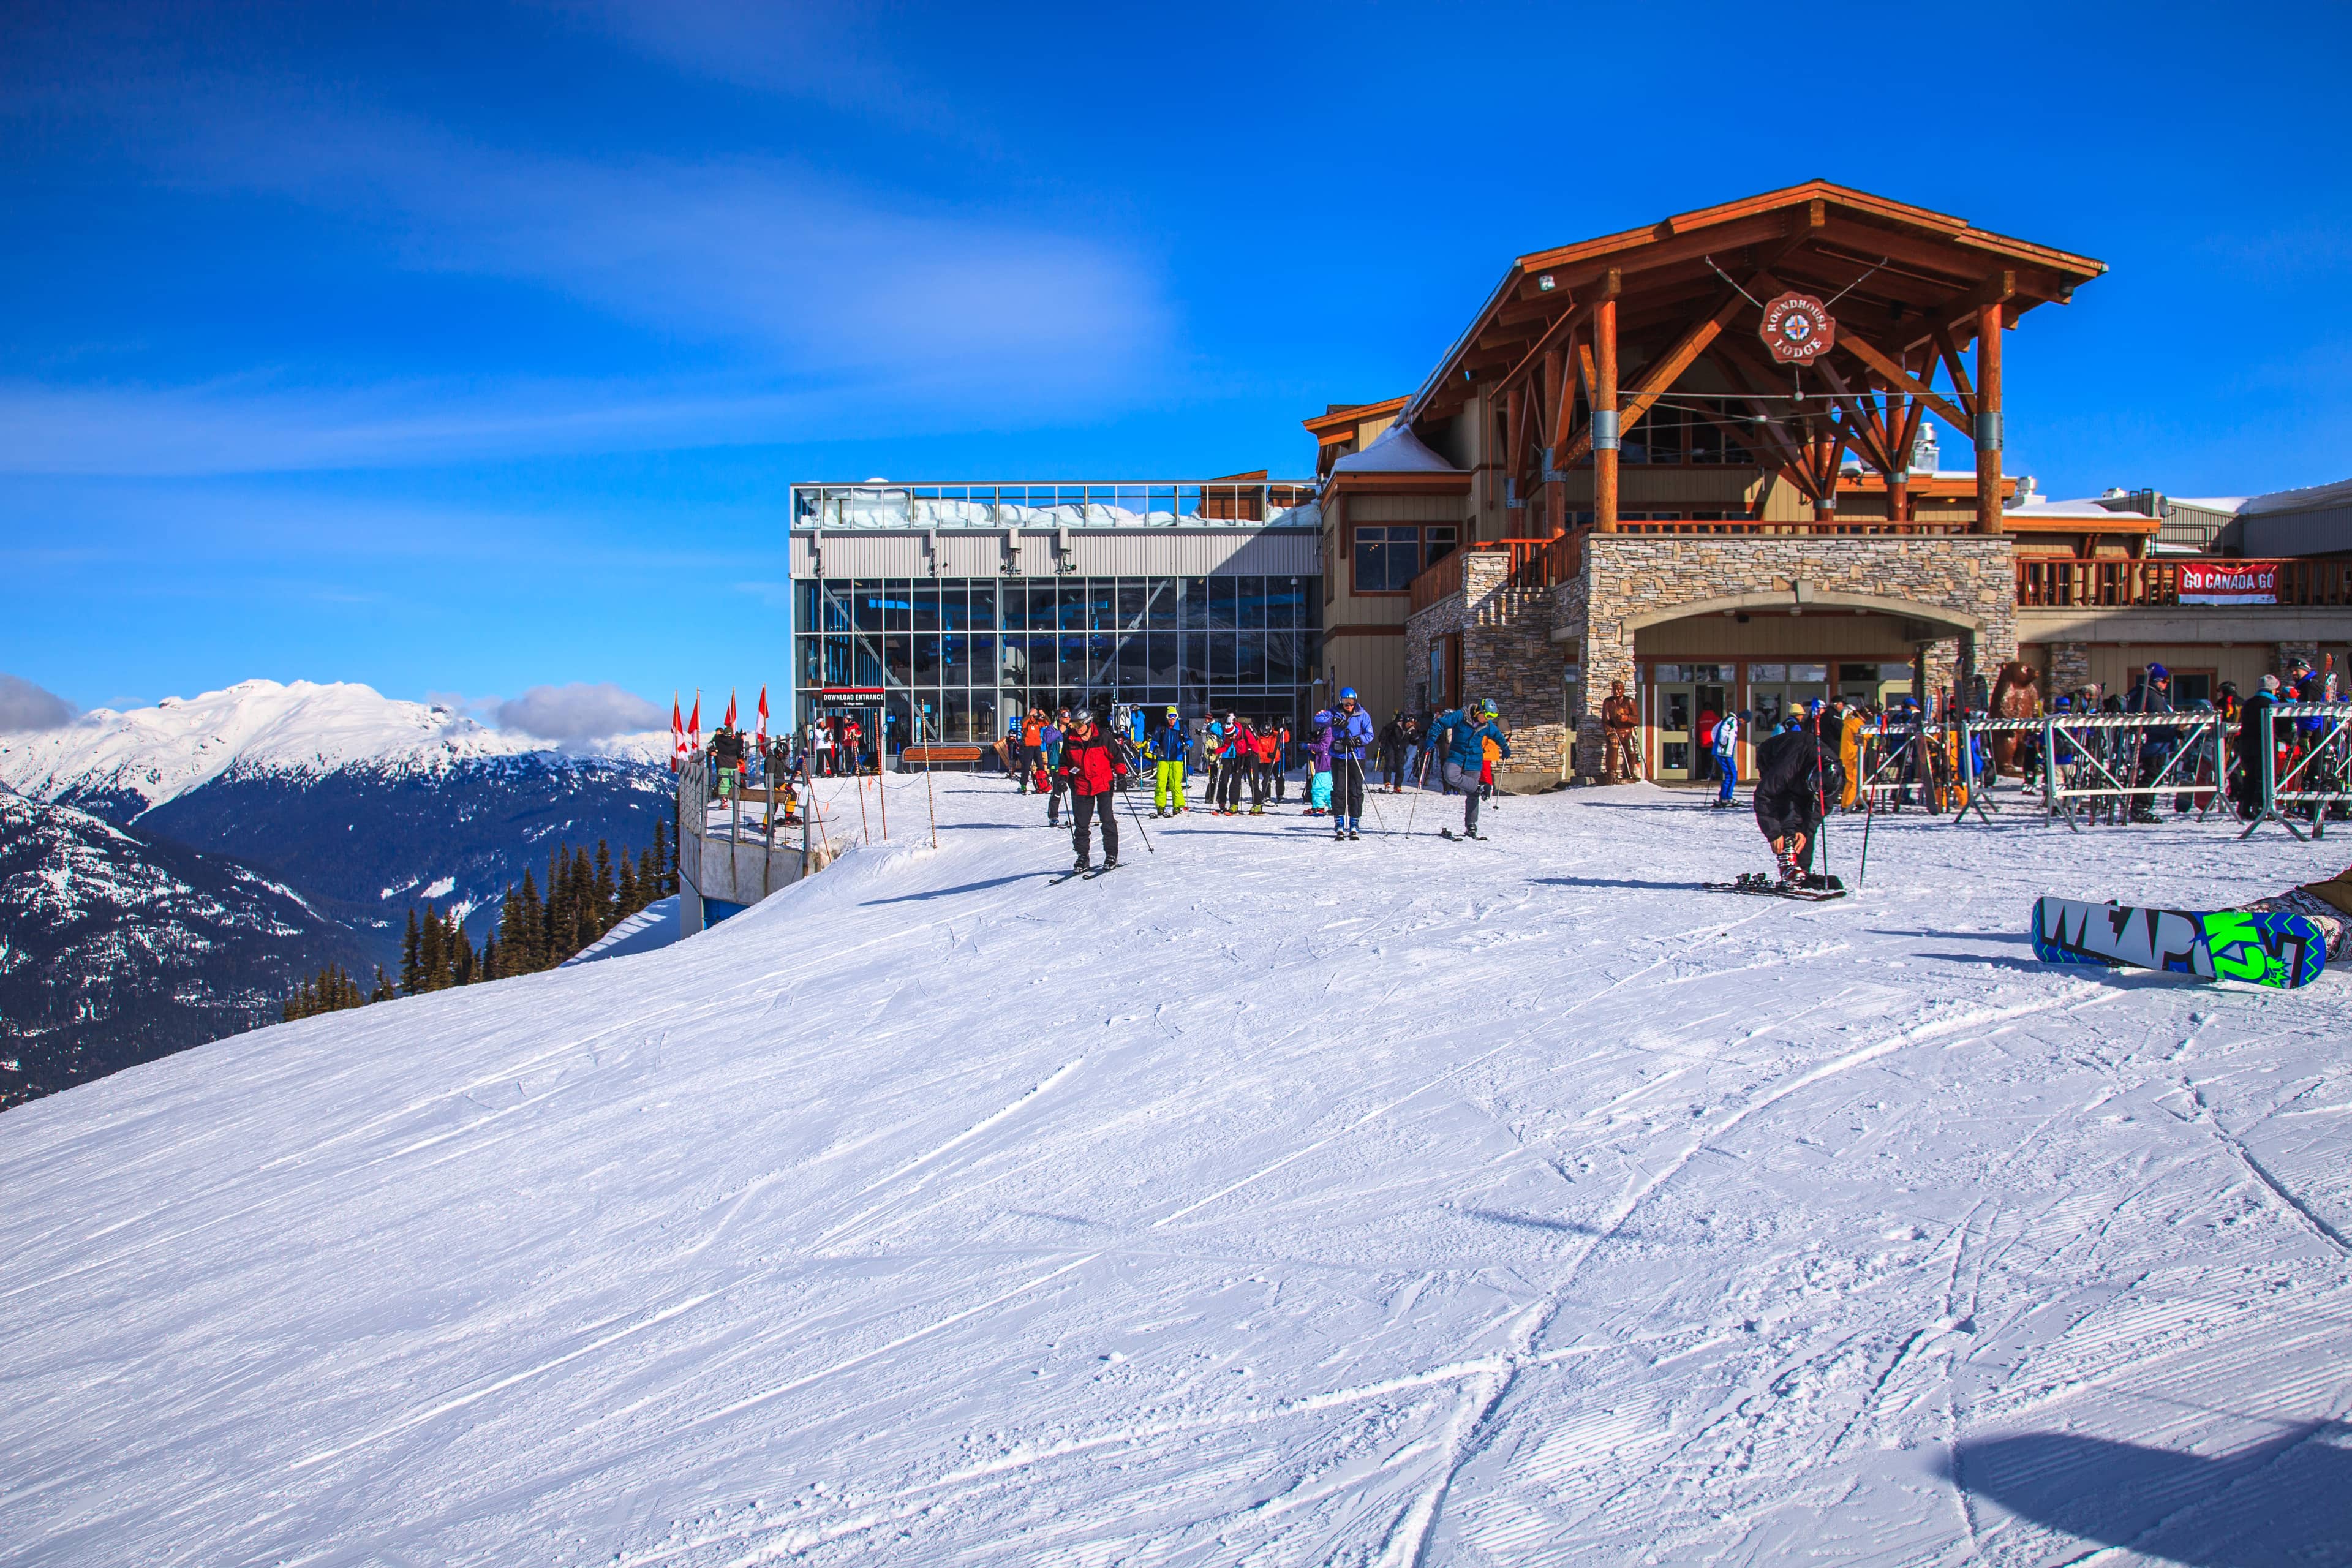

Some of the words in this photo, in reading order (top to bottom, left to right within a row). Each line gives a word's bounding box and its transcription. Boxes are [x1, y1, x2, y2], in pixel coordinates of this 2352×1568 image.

[1767, 299, 1827, 332] ROUNDHOUSE
[1773, 337, 1822, 358] LODGE
[2184, 573, 2201, 589] GO
[2205, 573, 2255, 589] CANADA
[2258, 573, 2274, 589] GO
